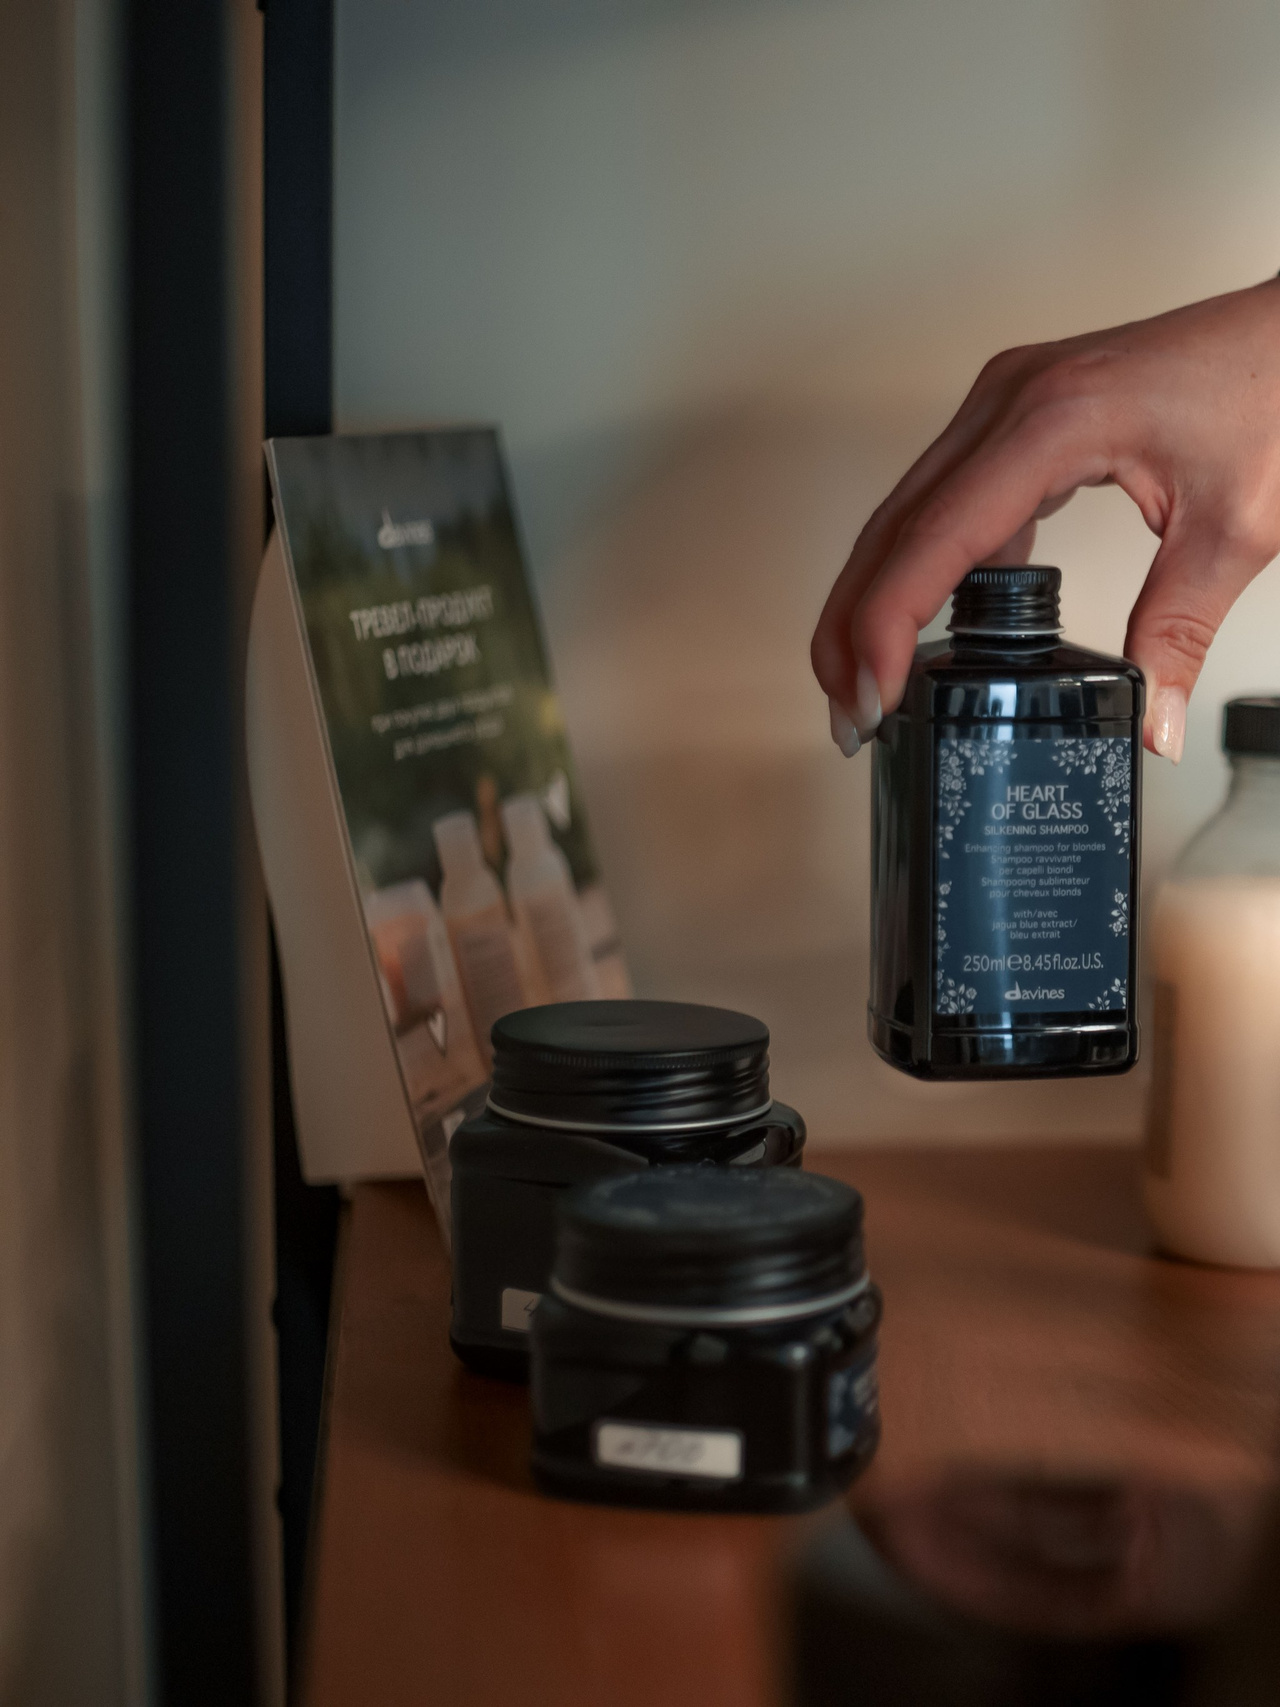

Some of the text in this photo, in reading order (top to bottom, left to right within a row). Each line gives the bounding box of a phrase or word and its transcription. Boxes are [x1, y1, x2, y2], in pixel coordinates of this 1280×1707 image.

[1007, 785, 1069, 802] HEART
[991, 802, 1083, 820] OF GLASS
[984, 824, 1089, 836] SILKENING SHAMPOO
[965, 842, 1106, 854] Enhancing shampoo for blondes
[991, 854, 1082, 865] Shampoo ravvivante
[999, 865, 1074, 876] per capelli biondi
[981, 876, 1091, 888] Shampooing sublimateur
[989, 887, 1082, 899] pour cheveux blonds
[992, 921, 1017, 932] jagua
[1019, 920, 1039, 929] blue
[1010, 930, 1061, 940] bleu extrait
[1004, 981, 1066, 1001] davines
